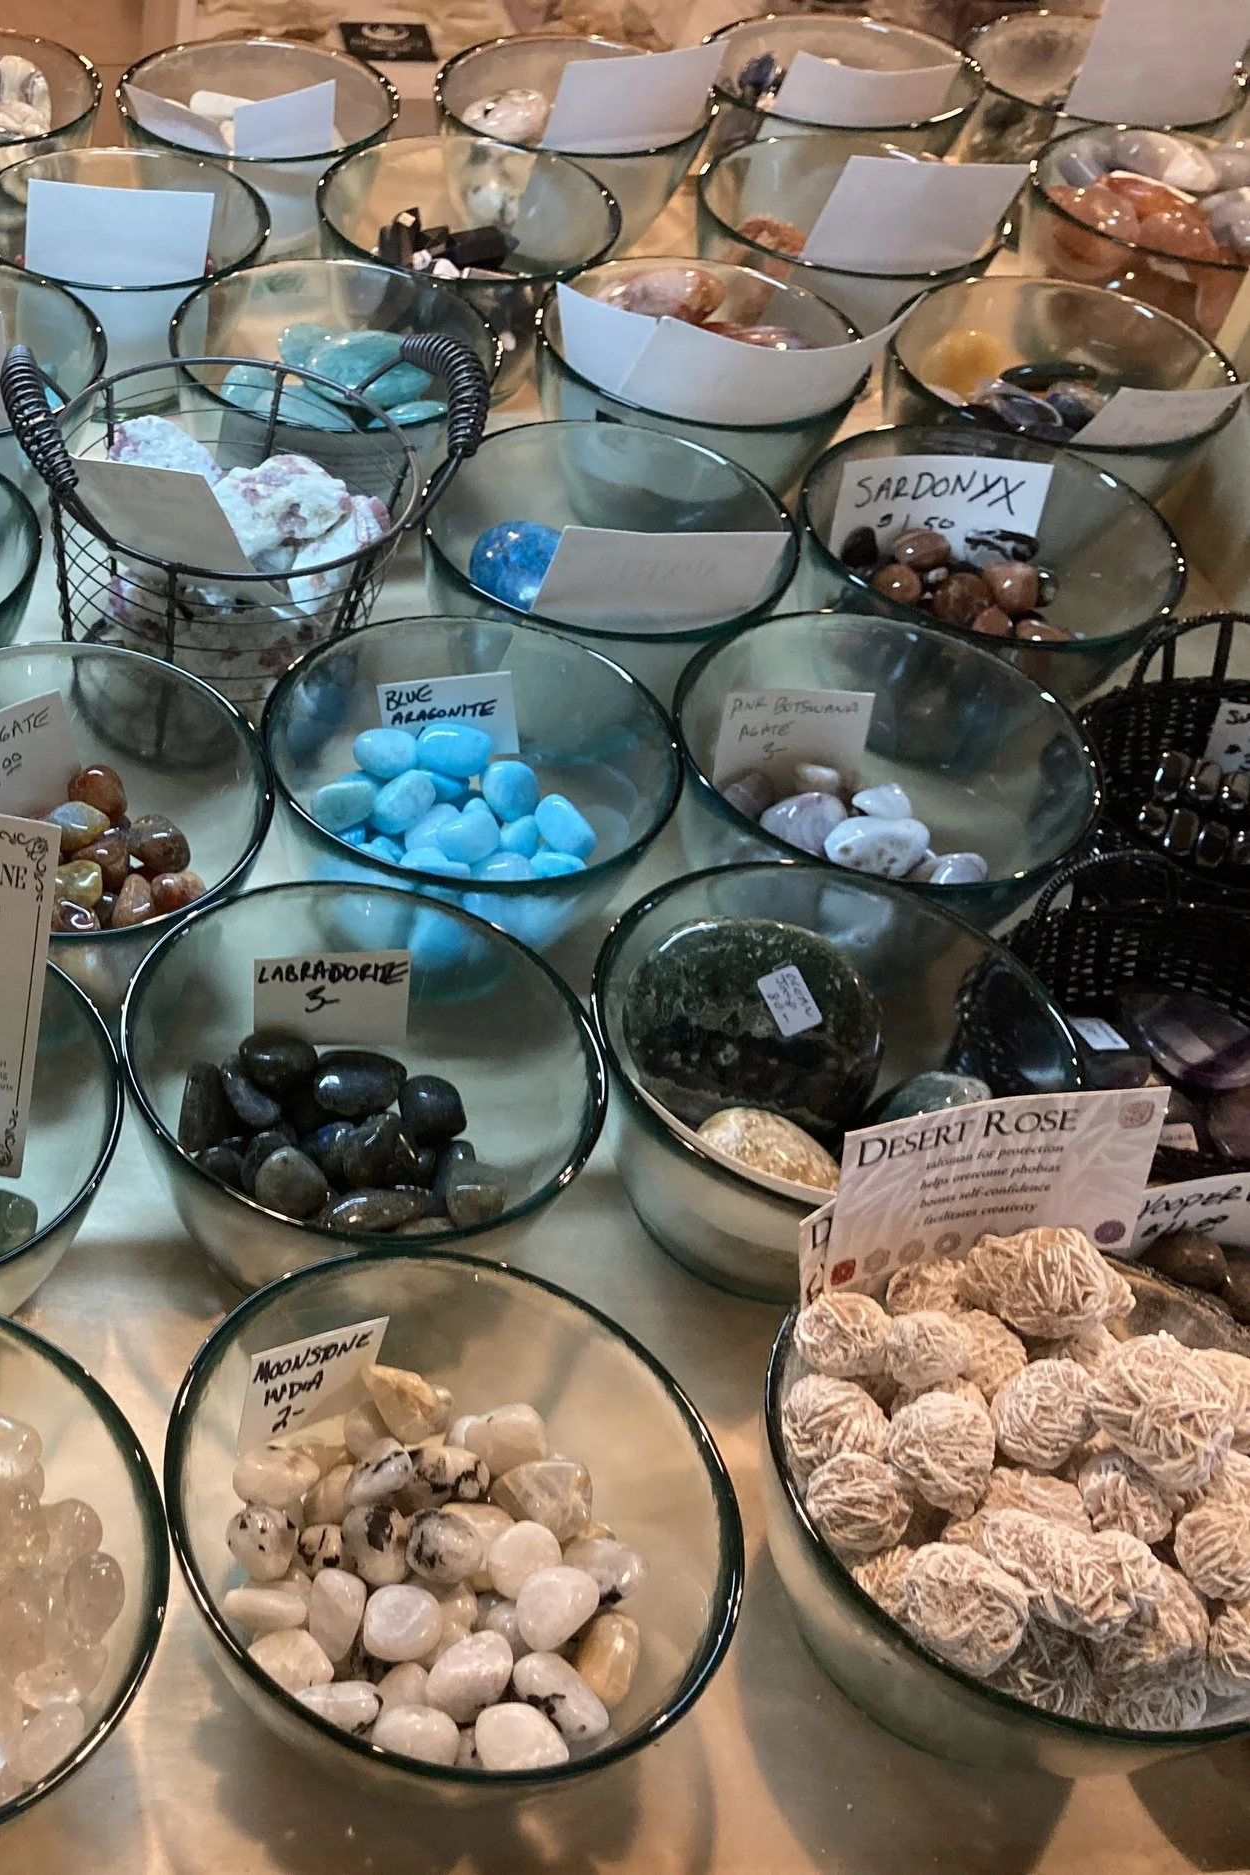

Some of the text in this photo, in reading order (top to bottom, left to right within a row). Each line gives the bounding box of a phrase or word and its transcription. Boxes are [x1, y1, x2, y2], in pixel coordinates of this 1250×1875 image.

[855, 470, 1026, 516] SARDONYX
[385, 684, 432, 711] BLUE
[773, 696, 859, 715] BOTSWANA
[391, 699, 497, 726] ARAGONITE
[738, 720, 796, 742] AGATE
[257, 959, 410, 985] LABRADORITE
[856, 1108, 1080, 1168] DESERT ROSE
[919, 1163, 1061, 1190] helps overcome phobias
[253, 1330, 374, 1384] MOONSTONE
[264, 1370, 324, 1407] INDIA
